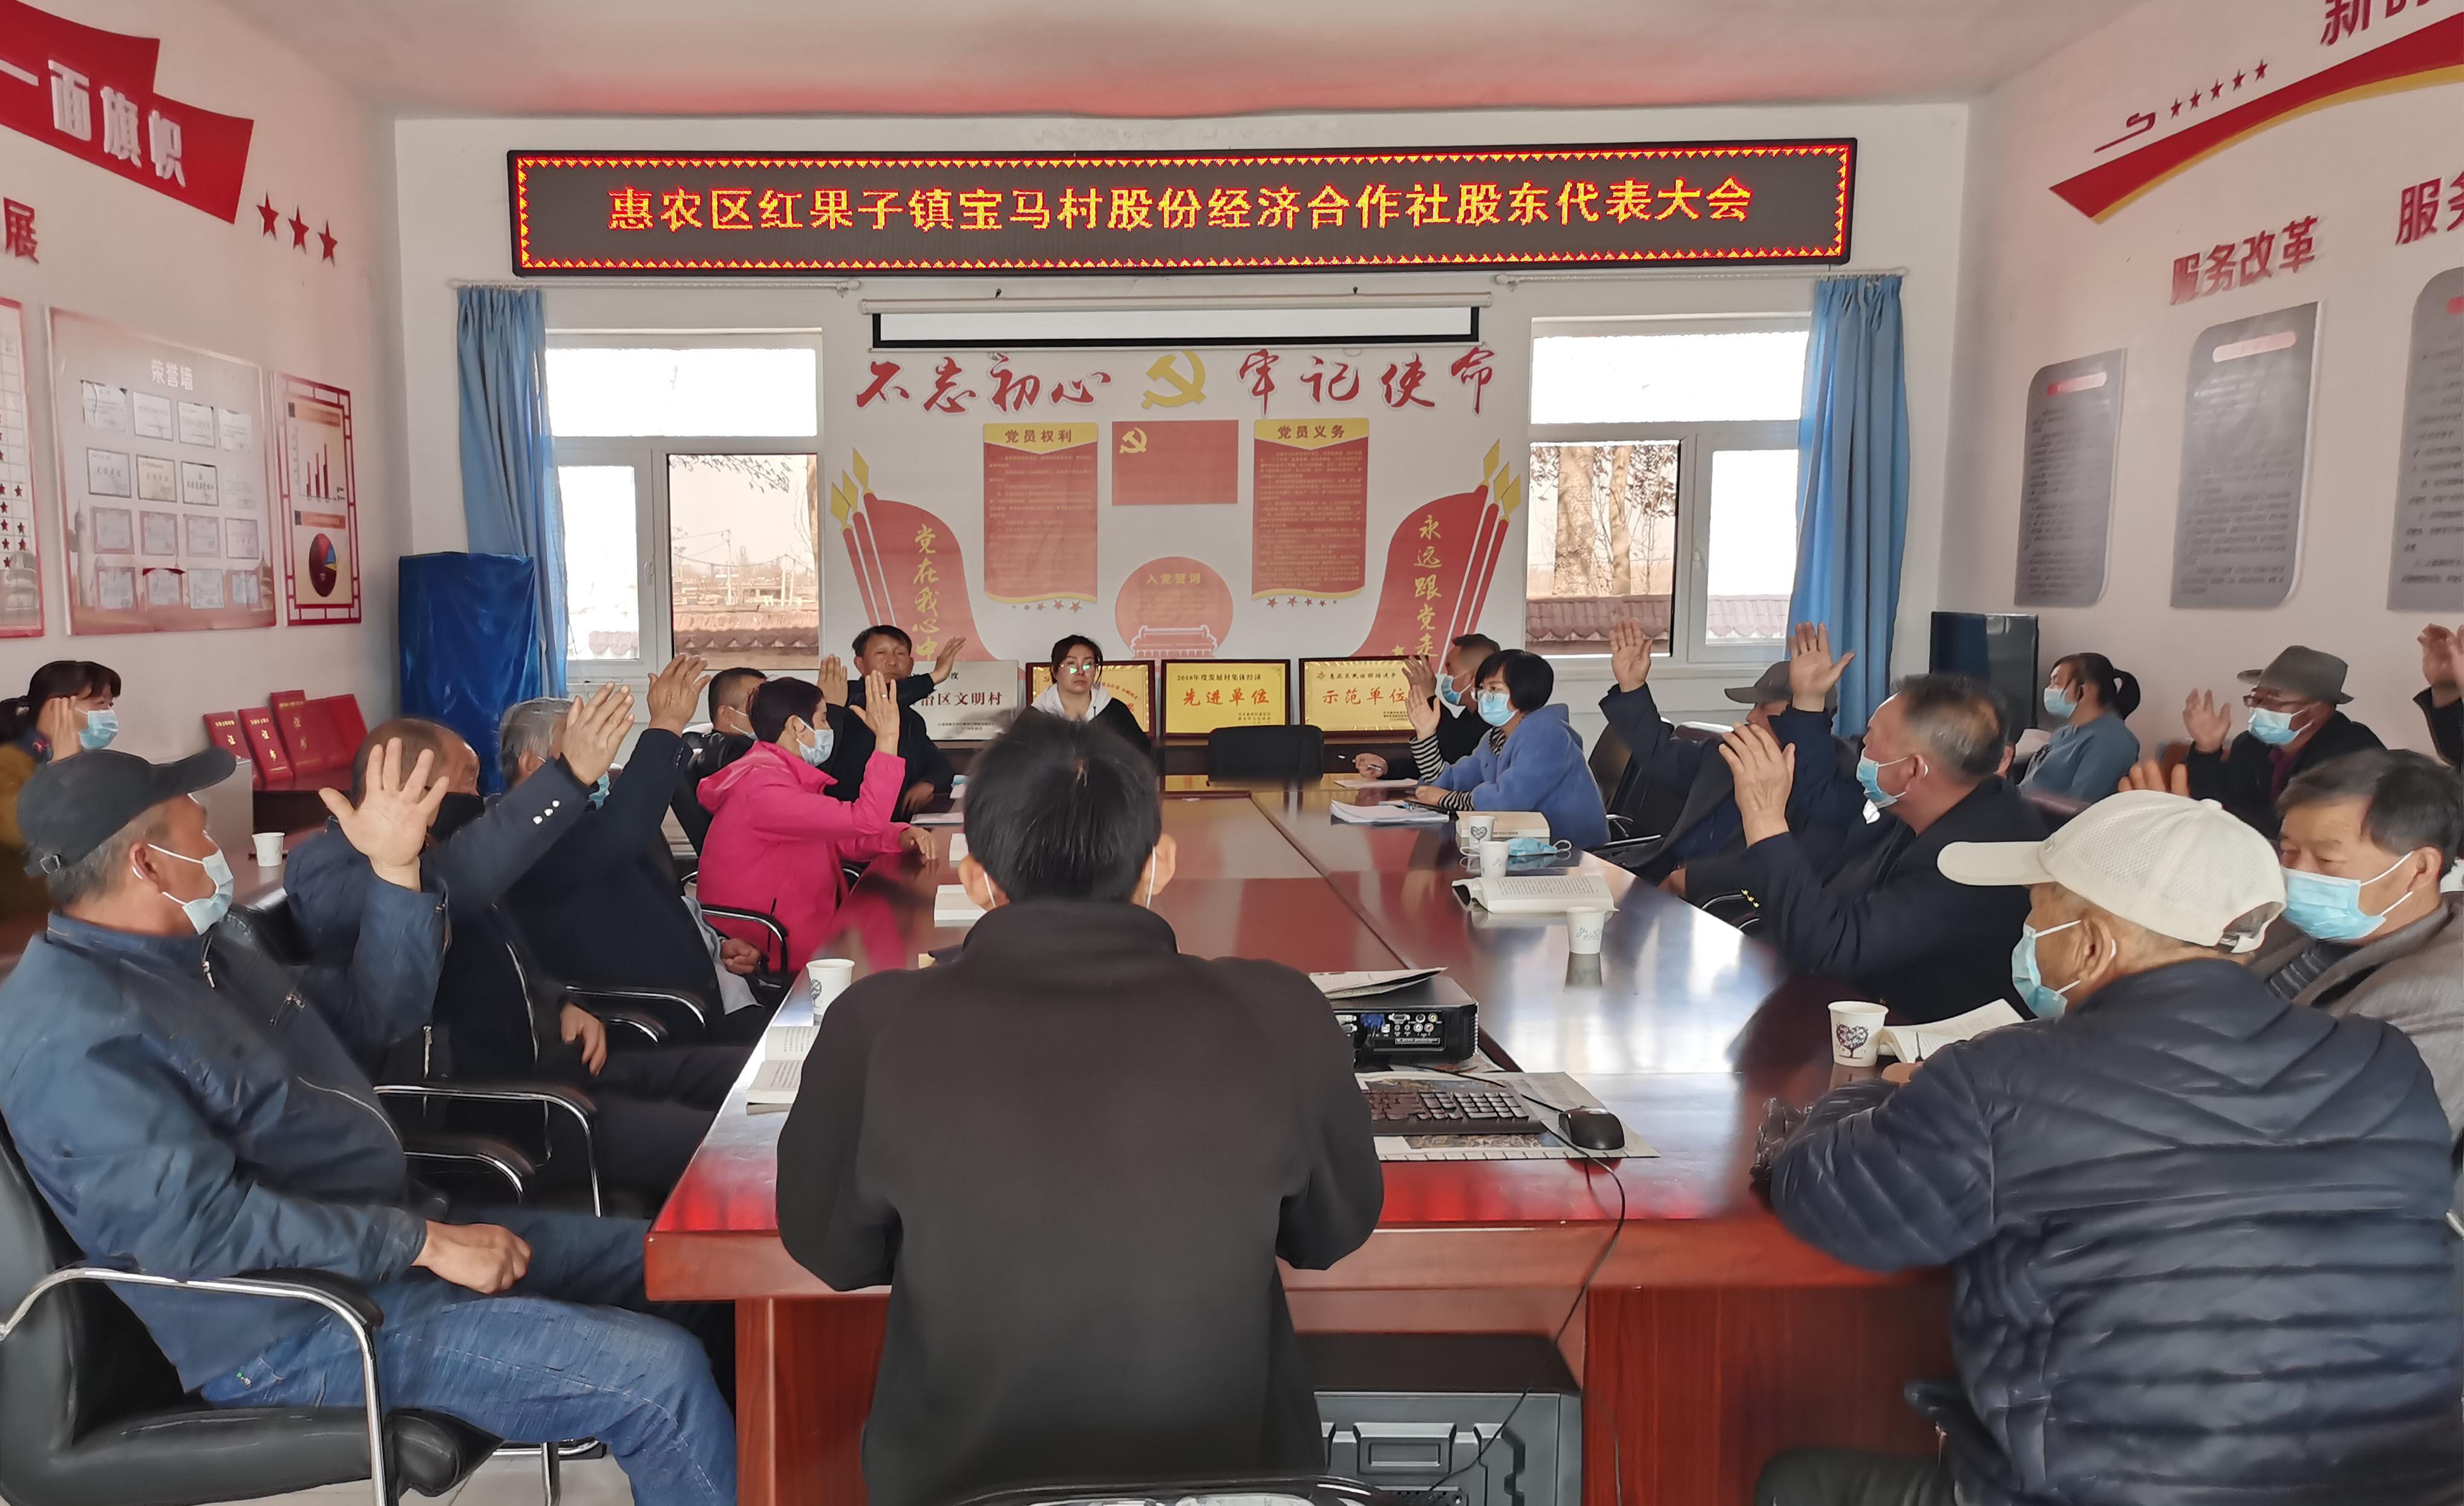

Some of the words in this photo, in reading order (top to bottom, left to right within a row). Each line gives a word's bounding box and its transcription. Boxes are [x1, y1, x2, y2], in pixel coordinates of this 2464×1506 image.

[2319, 0, 2431, 46] 新
[607, 176, 1753, 233] 惠农区红果子镇宝马村股份经济合作社股东代表大会
[3, 197, 39, 264] 展
[2171, 215, 2319, 305] 服务改革
[151, 359, 194, 391] 荣誉墙
[856, 352, 1112, 414] 不忘初心
[1238, 346, 1495, 416] 牢记使命
[1005, 429, 1072, 443] 党员权利
[1278, 425, 1345, 439] 党员义务
[912, 524, 940, 662] 党在我心中
[1146, 573, 1201, 584] 入党誓词
[1413, 515, 1443, 657] 永远跟党走
[1183, 687, 1270, 707] 先进单位
[1322, 686, 1407, 706] 示范单位
